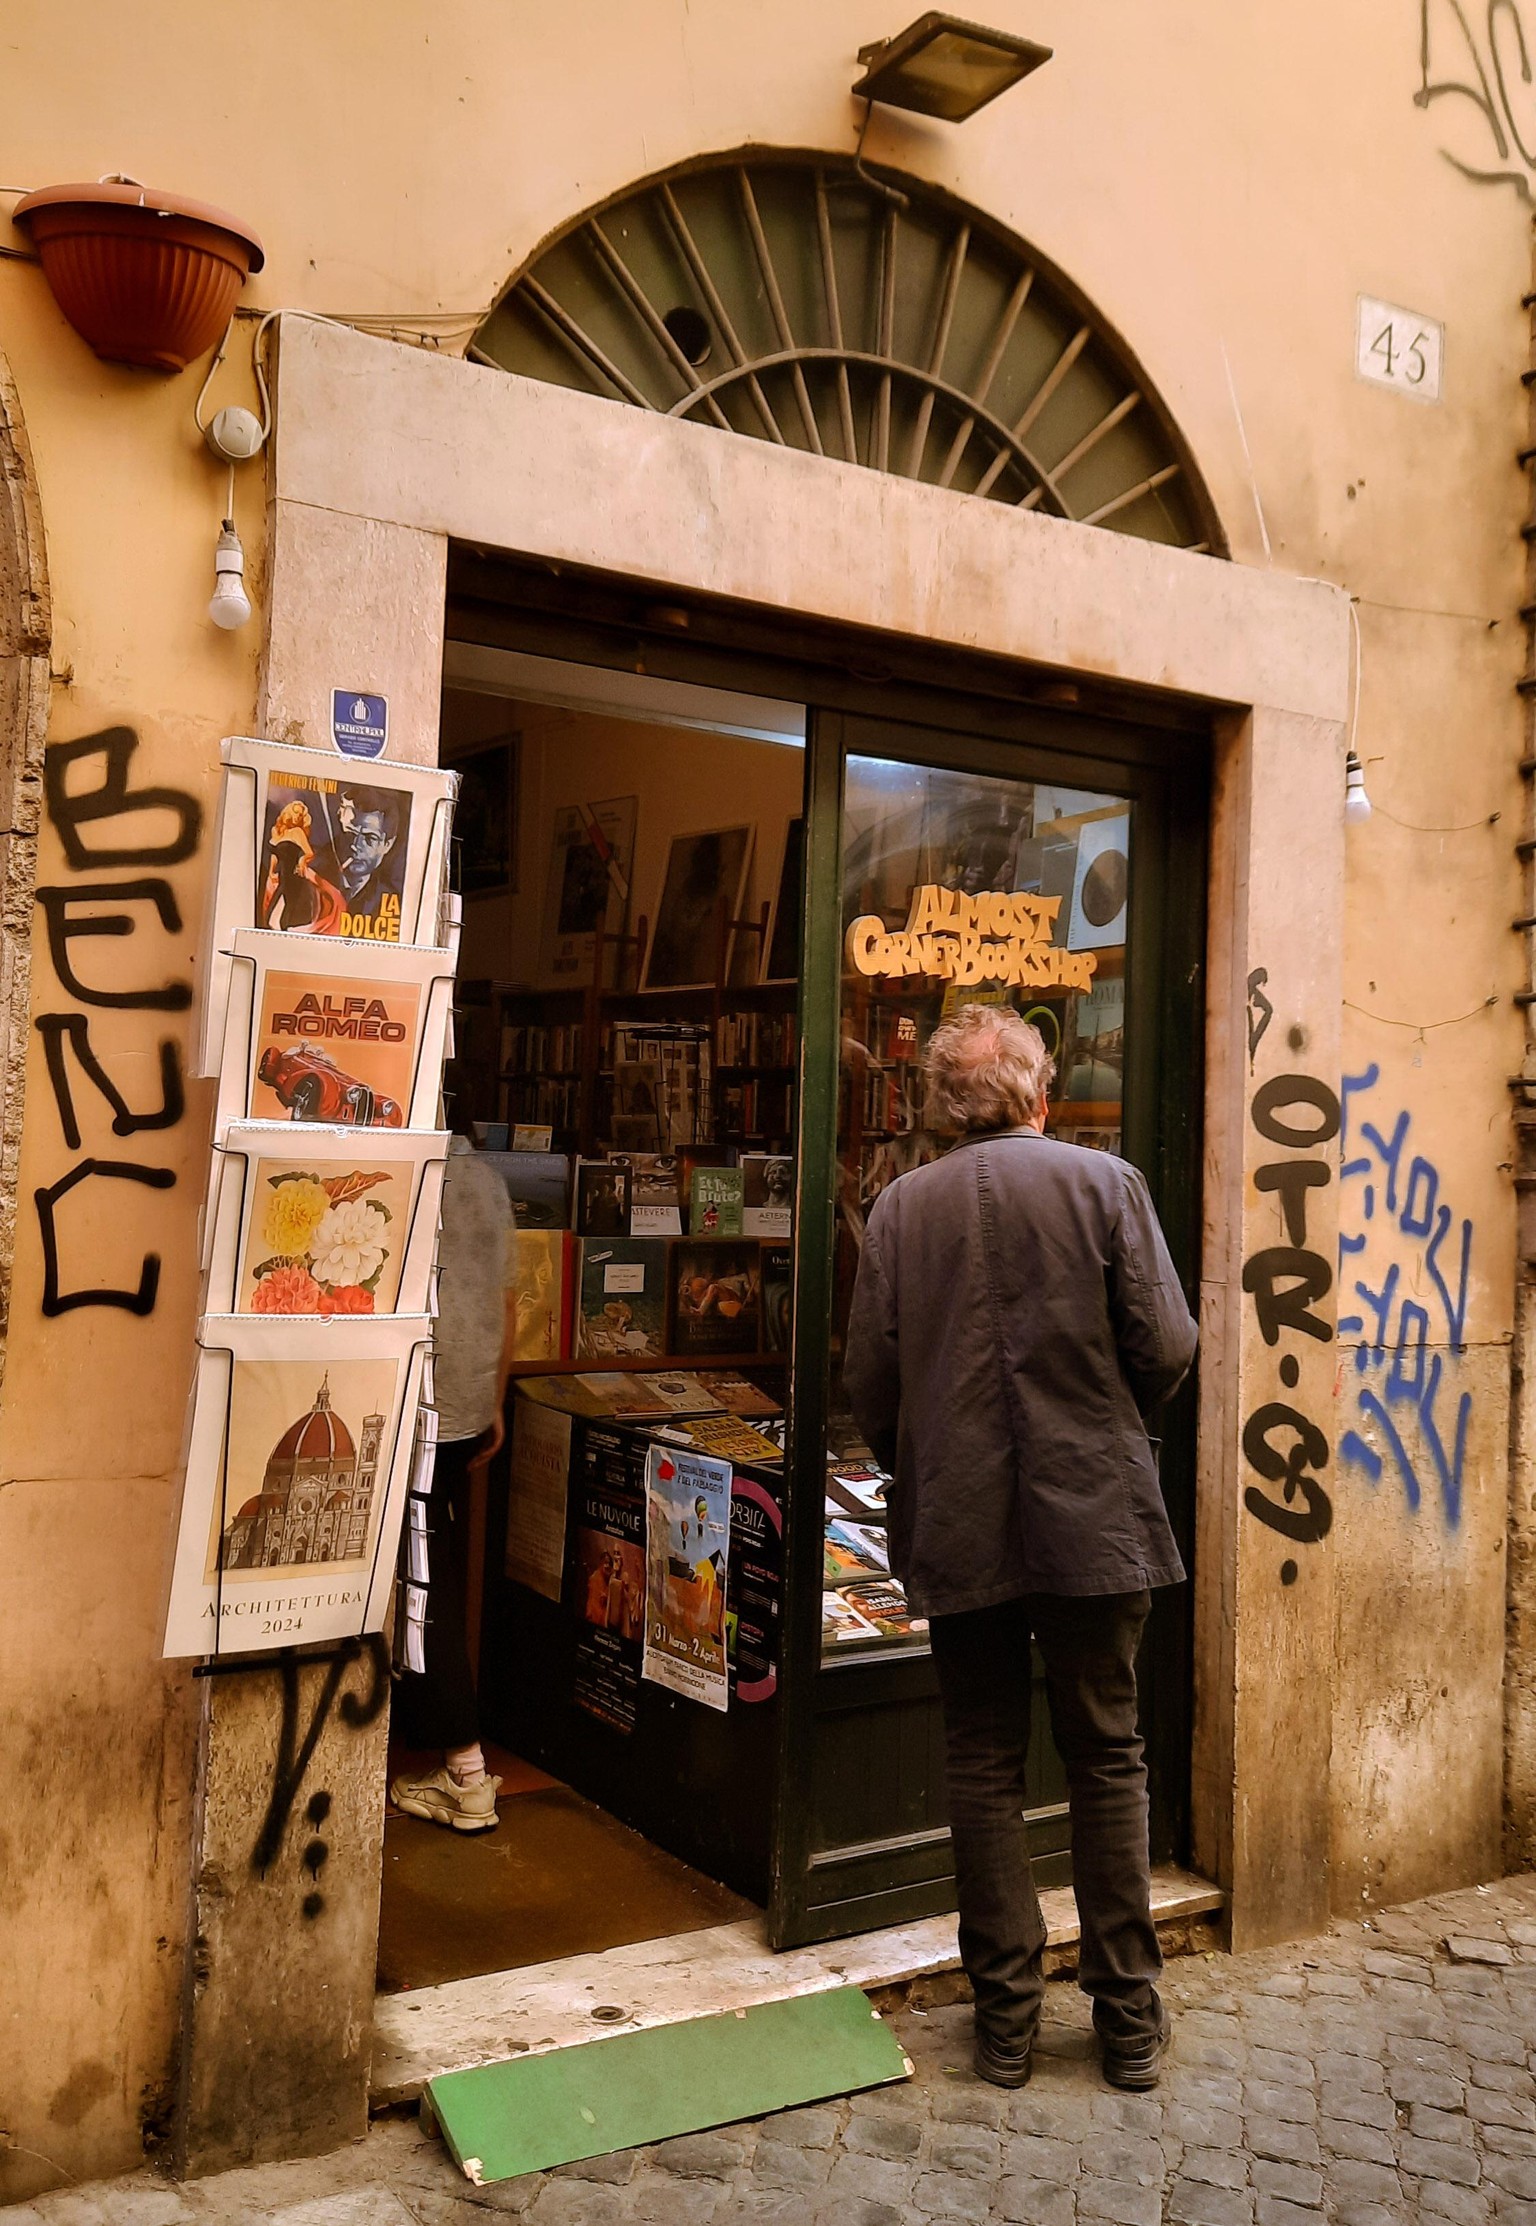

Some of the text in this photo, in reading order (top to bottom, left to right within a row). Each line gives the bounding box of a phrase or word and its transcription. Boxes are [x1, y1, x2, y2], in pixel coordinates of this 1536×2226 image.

[1370, 322, 1430, 384] 45
[308, 778, 338, 794] FELLINI
[380, 893, 400, 917] LA
[906, 884, 1062, 941] ALMOST
[340, 911, 400, 942] DOLCE
[293, 993, 389, 1021] ALFA
[271, 1013, 406, 1042] ROMEO
[587, 1499, 597, 1517] LE
[599, 1503, 641, 1532] NUVOLE
[200, 1591, 363, 1618] ARCHITETTURA
[261, 1617, 303, 1634] 2024
[655, 1622, 666, 1643] 31
[692, 1638, 699, 1656] 2
